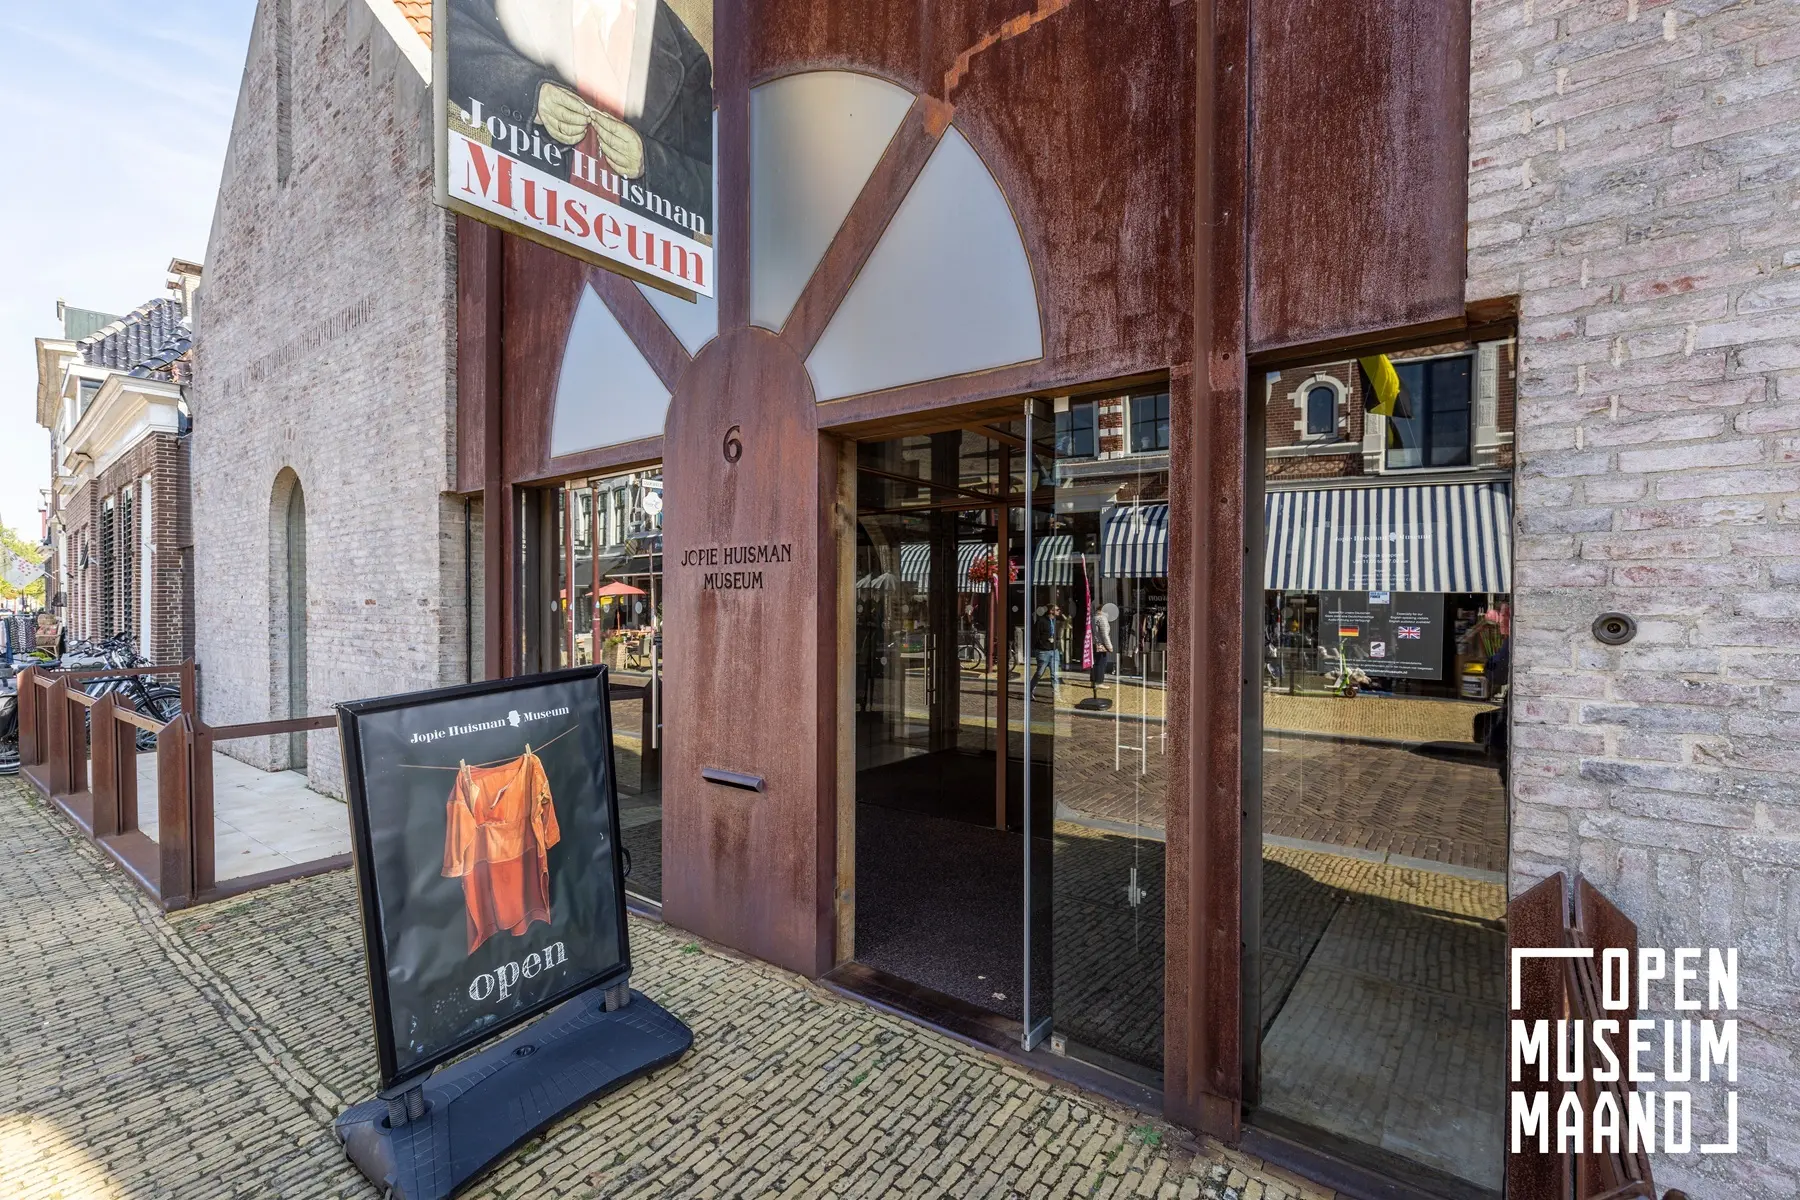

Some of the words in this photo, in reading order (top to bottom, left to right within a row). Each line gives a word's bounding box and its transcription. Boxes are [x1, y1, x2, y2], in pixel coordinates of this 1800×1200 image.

[461, 97, 562, 166] Jopie
[572, 148, 706, 236] Huisman
[461, 138, 706, 288] Museum
[723, 425, 743, 463] 6
[681, 548, 718, 567] JOPIE
[723, 544, 792, 565] HUISMAN
[703, 571, 764, 590] MUSEUM
[410, 729, 446, 744] Jopie
[448, 718, 506, 737] Huisman
[522, 705, 570, 723] Museum
[468, 940, 569, 1004] open
